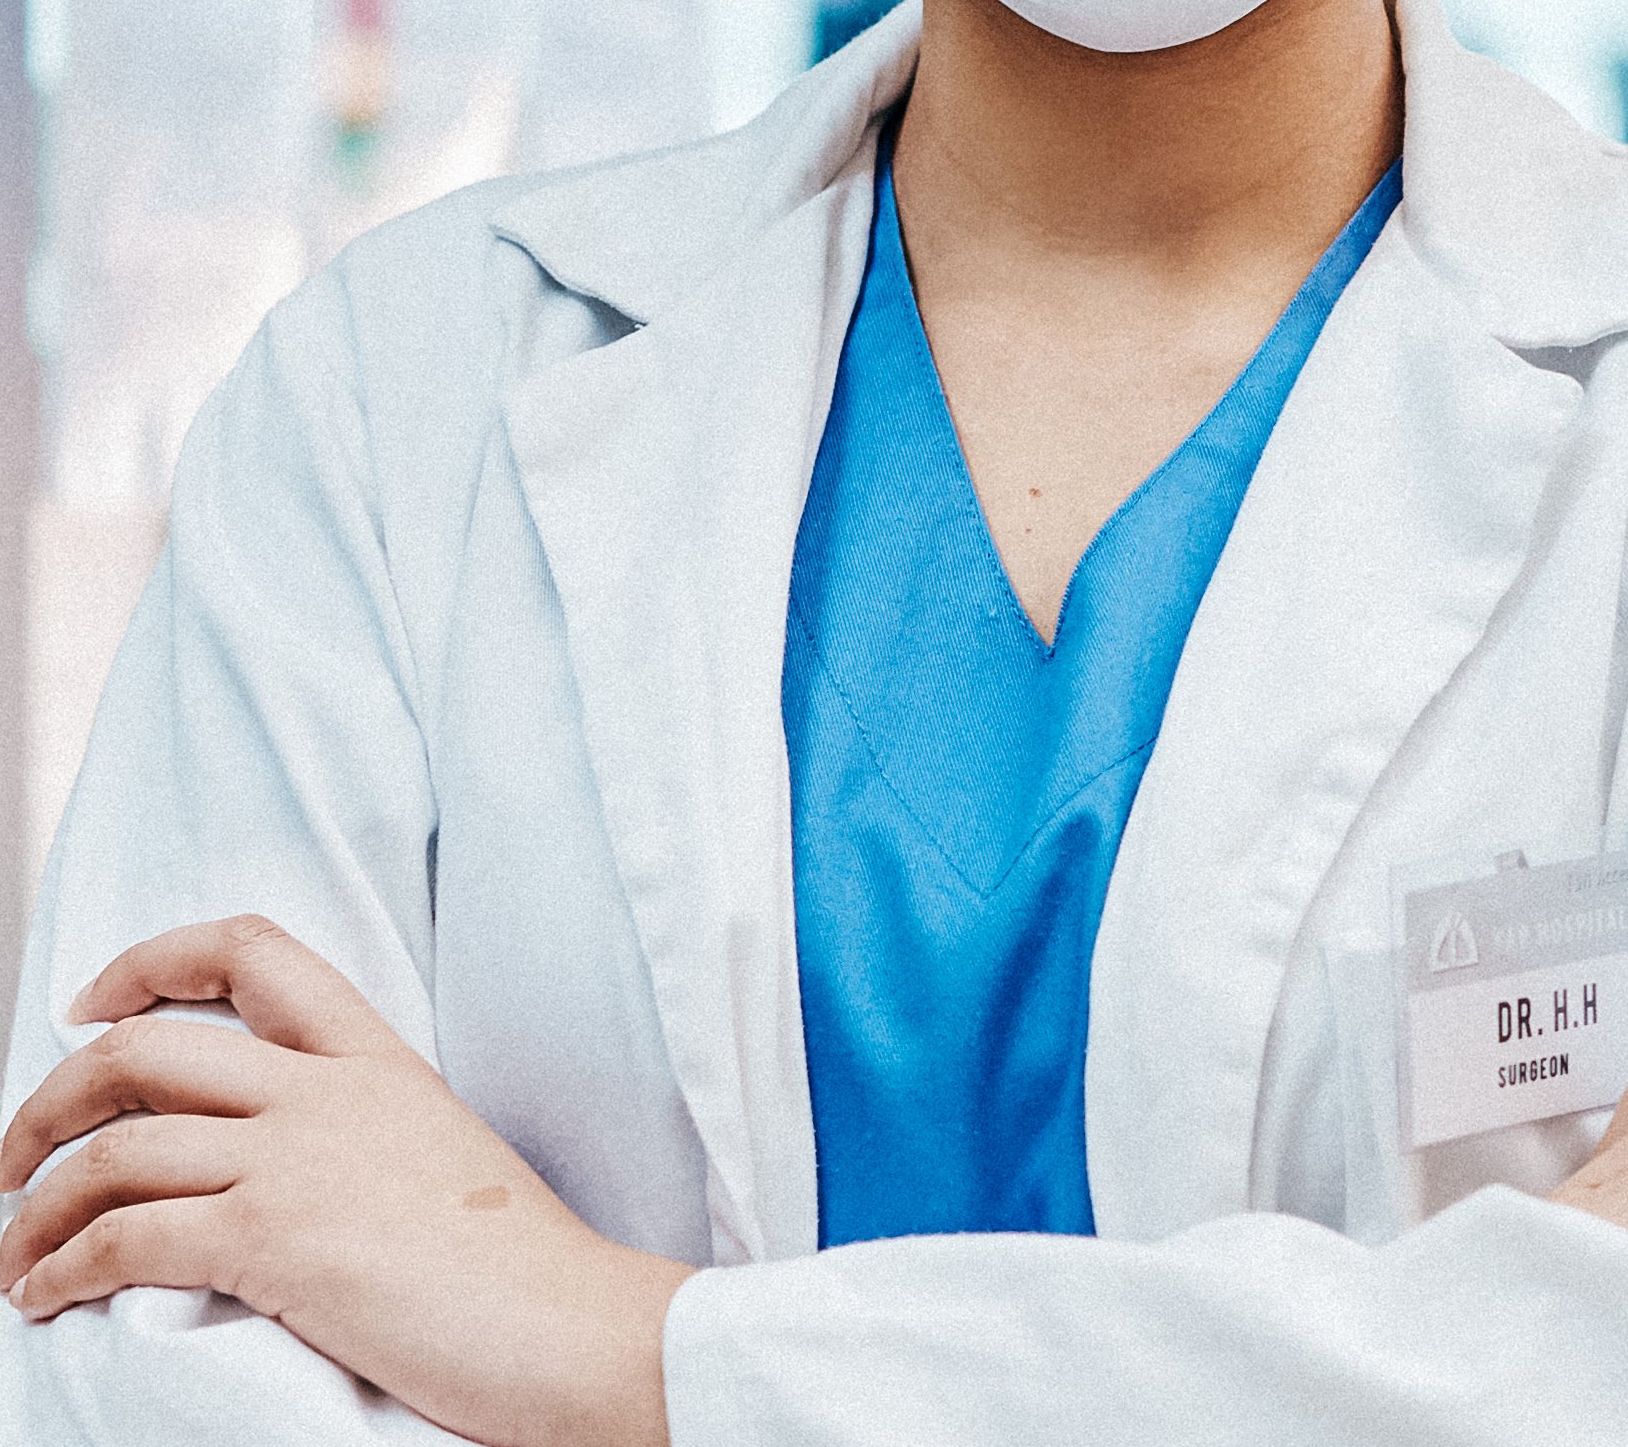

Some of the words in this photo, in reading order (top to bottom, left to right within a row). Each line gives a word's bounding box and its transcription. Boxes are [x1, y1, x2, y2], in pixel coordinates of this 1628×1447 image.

[1534, 905, 1628, 946] HOSPITAL
[1498, 997, 1543, 1043] DR.
[1554, 983, 1597, 1032] H.H
[1498, 1053, 1569, 1088] SURGEON
